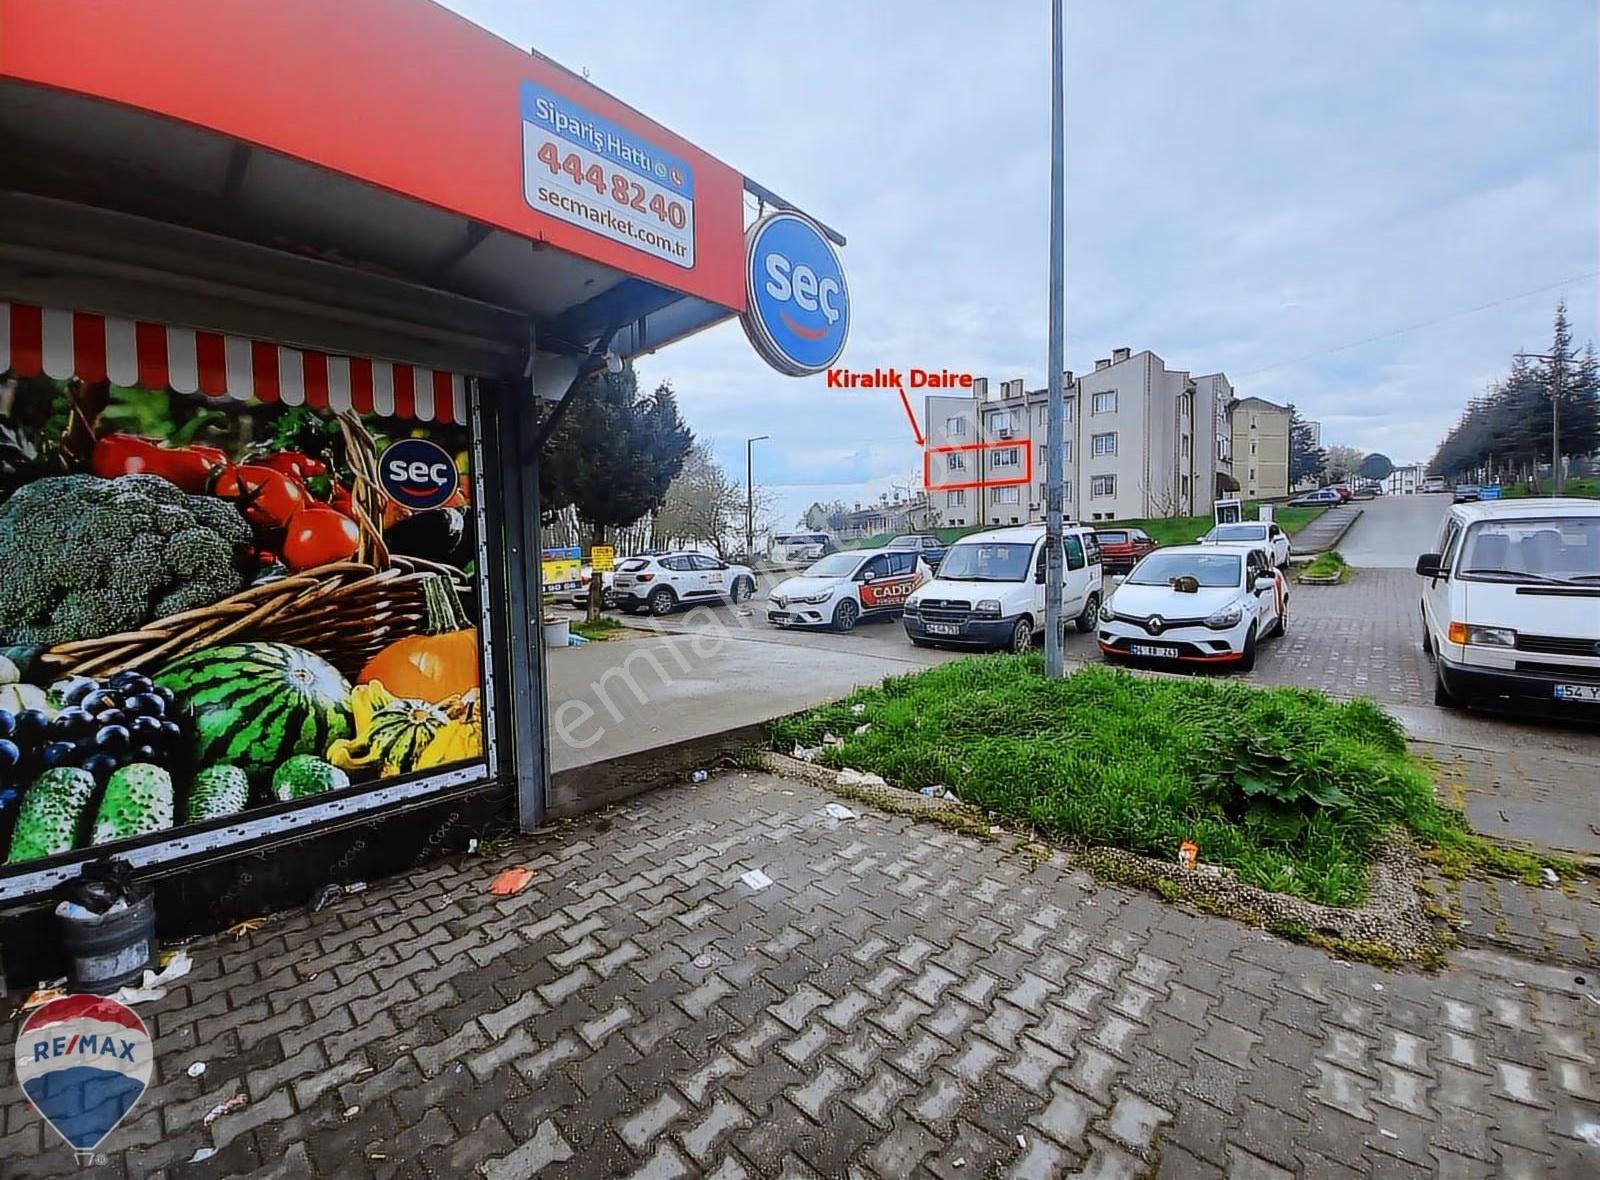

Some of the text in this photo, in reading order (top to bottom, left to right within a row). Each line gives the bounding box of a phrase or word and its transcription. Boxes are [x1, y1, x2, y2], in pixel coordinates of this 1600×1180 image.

[536, 98, 651, 171] Sipariş Hattı
[538, 187, 687, 257] secmarket.com.tr
[765, 253, 840, 324] seç
[389, 460, 448, 486] seç
[1565, 685, 1583, 697] 54
